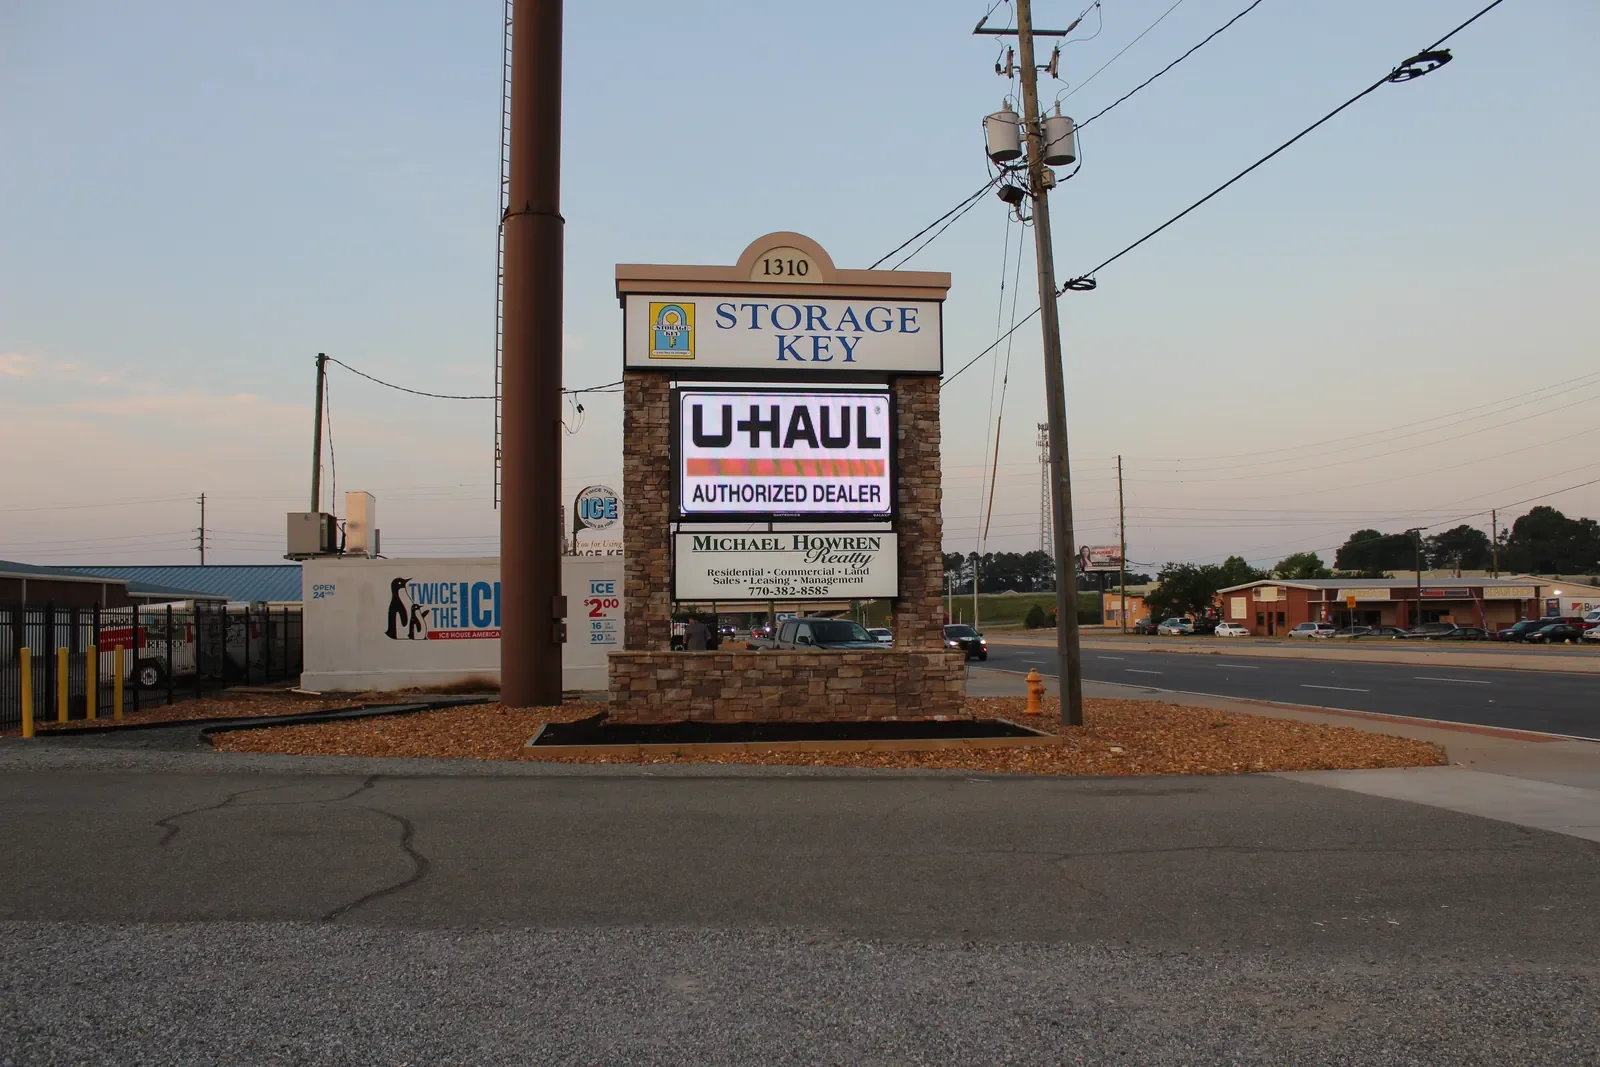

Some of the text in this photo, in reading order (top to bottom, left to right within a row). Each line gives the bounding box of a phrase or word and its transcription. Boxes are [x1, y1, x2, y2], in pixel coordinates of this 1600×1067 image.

[763, 258, 809, 276] 1310
[715, 303, 921, 333] STORAGE
[774, 334, 863, 362] KEY
[692, 404, 881, 449] U-HAUL
[585, 487, 614, 497] TWICE THE
[692, 484, 881, 503] AUTHORIZED DEALER
[581, 497, 618, 519] ICE
[591, 540, 601, 549] for
[603, 540, 622, 549] Using
[692, 534, 881, 551] MICHAEL HOWREN
[804, 547, 875, 569] Realty
[707, 567, 870, 577] Residential Commercial Land
[591, 583, 614, 594] ICE
[713, 576, 864, 587] Sales Leasing Management
[313, 591, 325, 599] 24
[409, 582, 458, 604] TWICE
[748, 586, 829, 596] 770-382-8585
[1485, 588, 1533, 597] REPAIR SHOP
[431, 607, 458, 628] THE
[592, 622, 602, 630] 16
